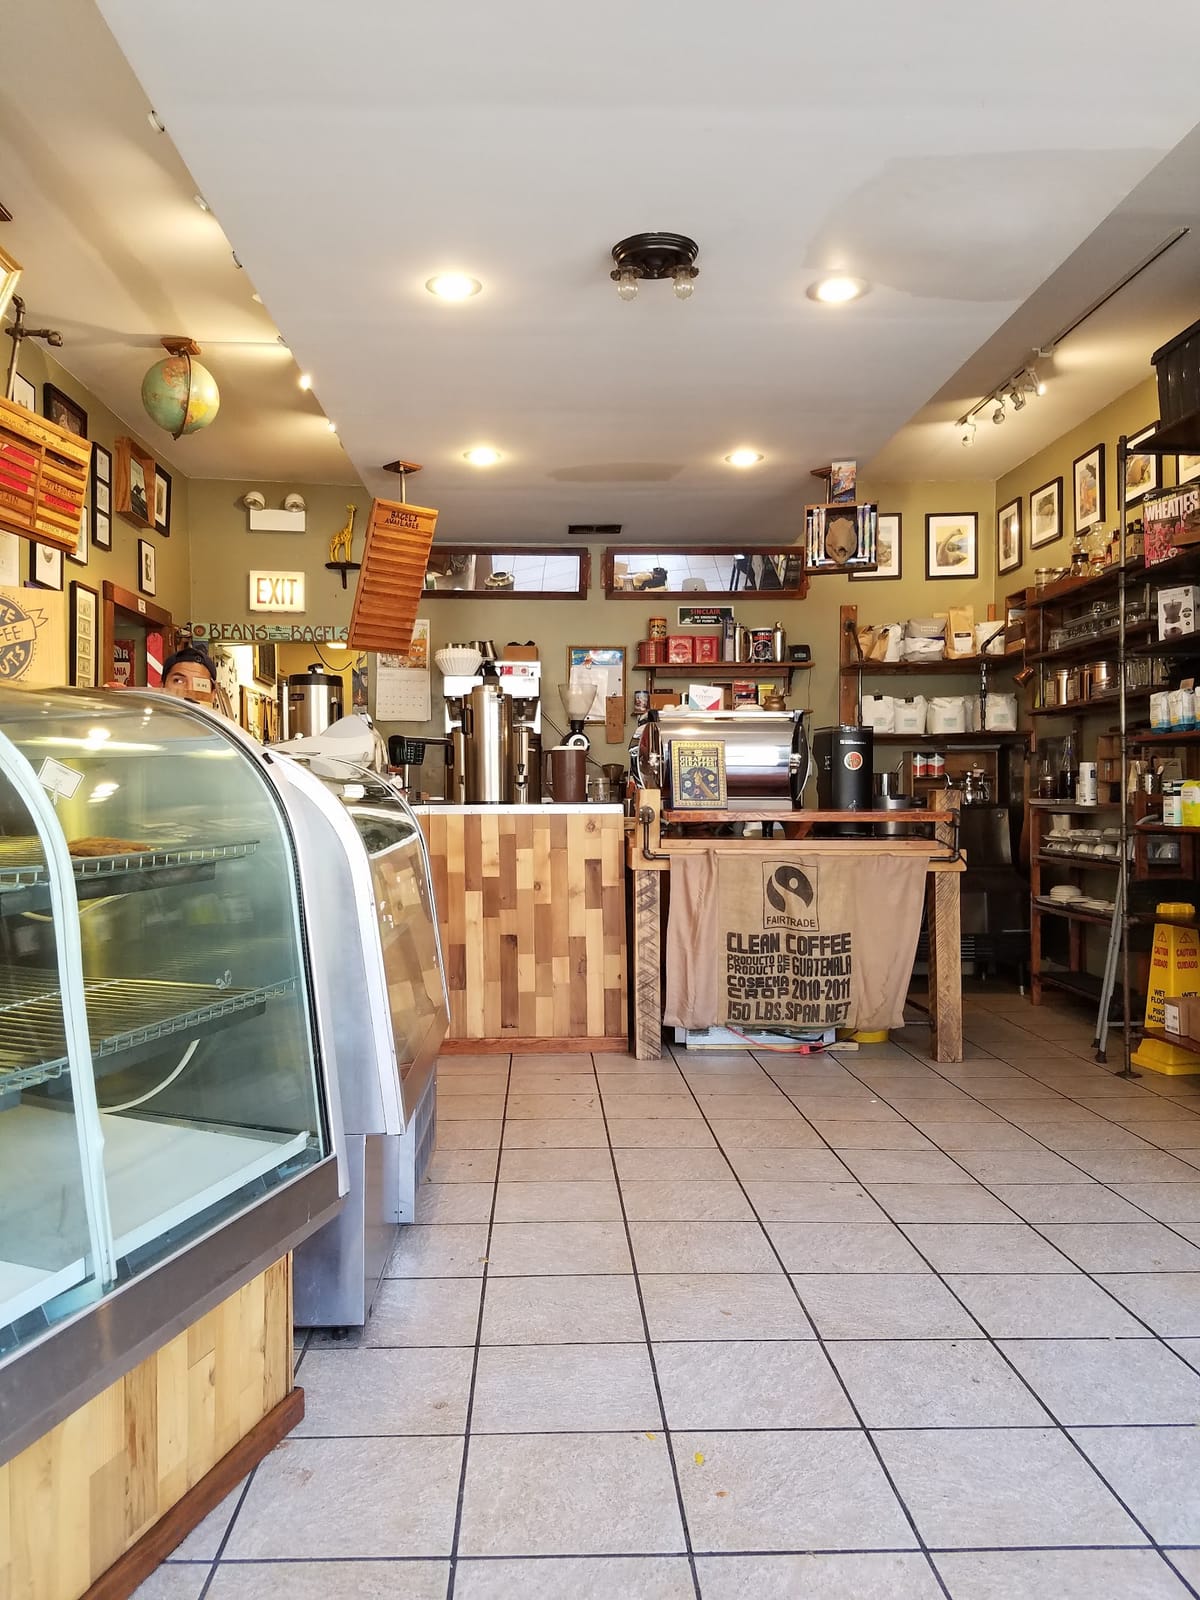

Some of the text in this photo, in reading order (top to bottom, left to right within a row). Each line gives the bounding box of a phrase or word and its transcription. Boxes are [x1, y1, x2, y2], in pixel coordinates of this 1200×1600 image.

[1145, 490, 1199, 521] WHEATIES
[256, 577, 297, 605] EXIT
[209, 623, 268, 641] BEANS
[291, 624, 349, 642] BAGELS
[766, 915, 816, 928] FAIRTRADE
[726, 931, 852, 956] CLEAN COFFEE
[727, 953, 791, 966] PRODUCTO DE
[1176, 948, 1198, 958] CAUTION
[727, 964, 791, 975] PRODUCT OF
[791, 954, 852, 977] GUATEMALA
[1176, 960, 1199, 970] CUIDADO
[727, 974, 790, 989] COSECHA
[727, 986, 790, 1000] CROP
[791, 977, 851, 1001] 2010-2011
[1154, 989, 1165, 998] WET
[1151, 997, 1165, 1005] FLOO
[727, 999, 751, 1021] 150
[1153, 1007, 1166, 1016] PISO
[1147, 1014, 1166, 1025] MOJAD
